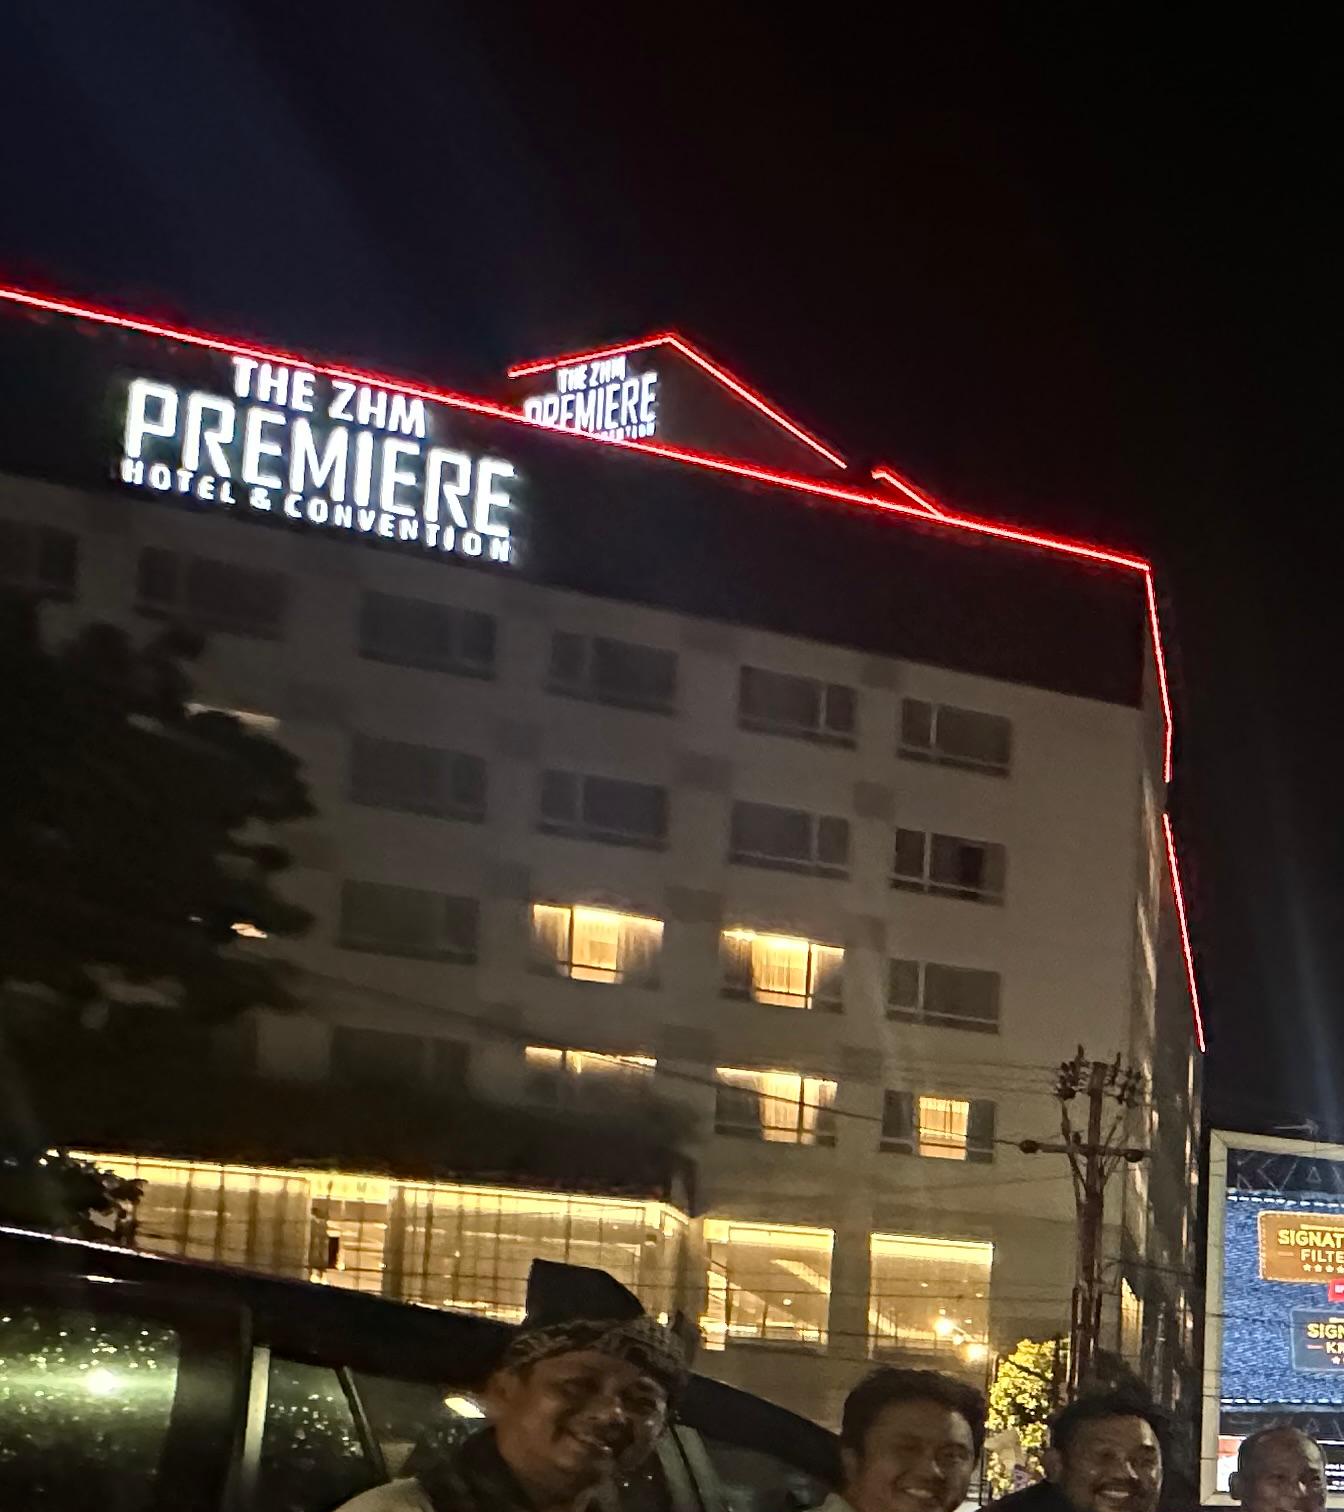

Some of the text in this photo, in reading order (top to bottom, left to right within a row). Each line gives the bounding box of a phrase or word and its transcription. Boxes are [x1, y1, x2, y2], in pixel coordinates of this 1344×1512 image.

[231, 355, 427, 440] THE ZHM
[557, 354, 626, 394] THE ZHM
[124, 377, 516, 539] PREMIERE
[120, 458, 513, 564] HOTEL & CONVENTION
